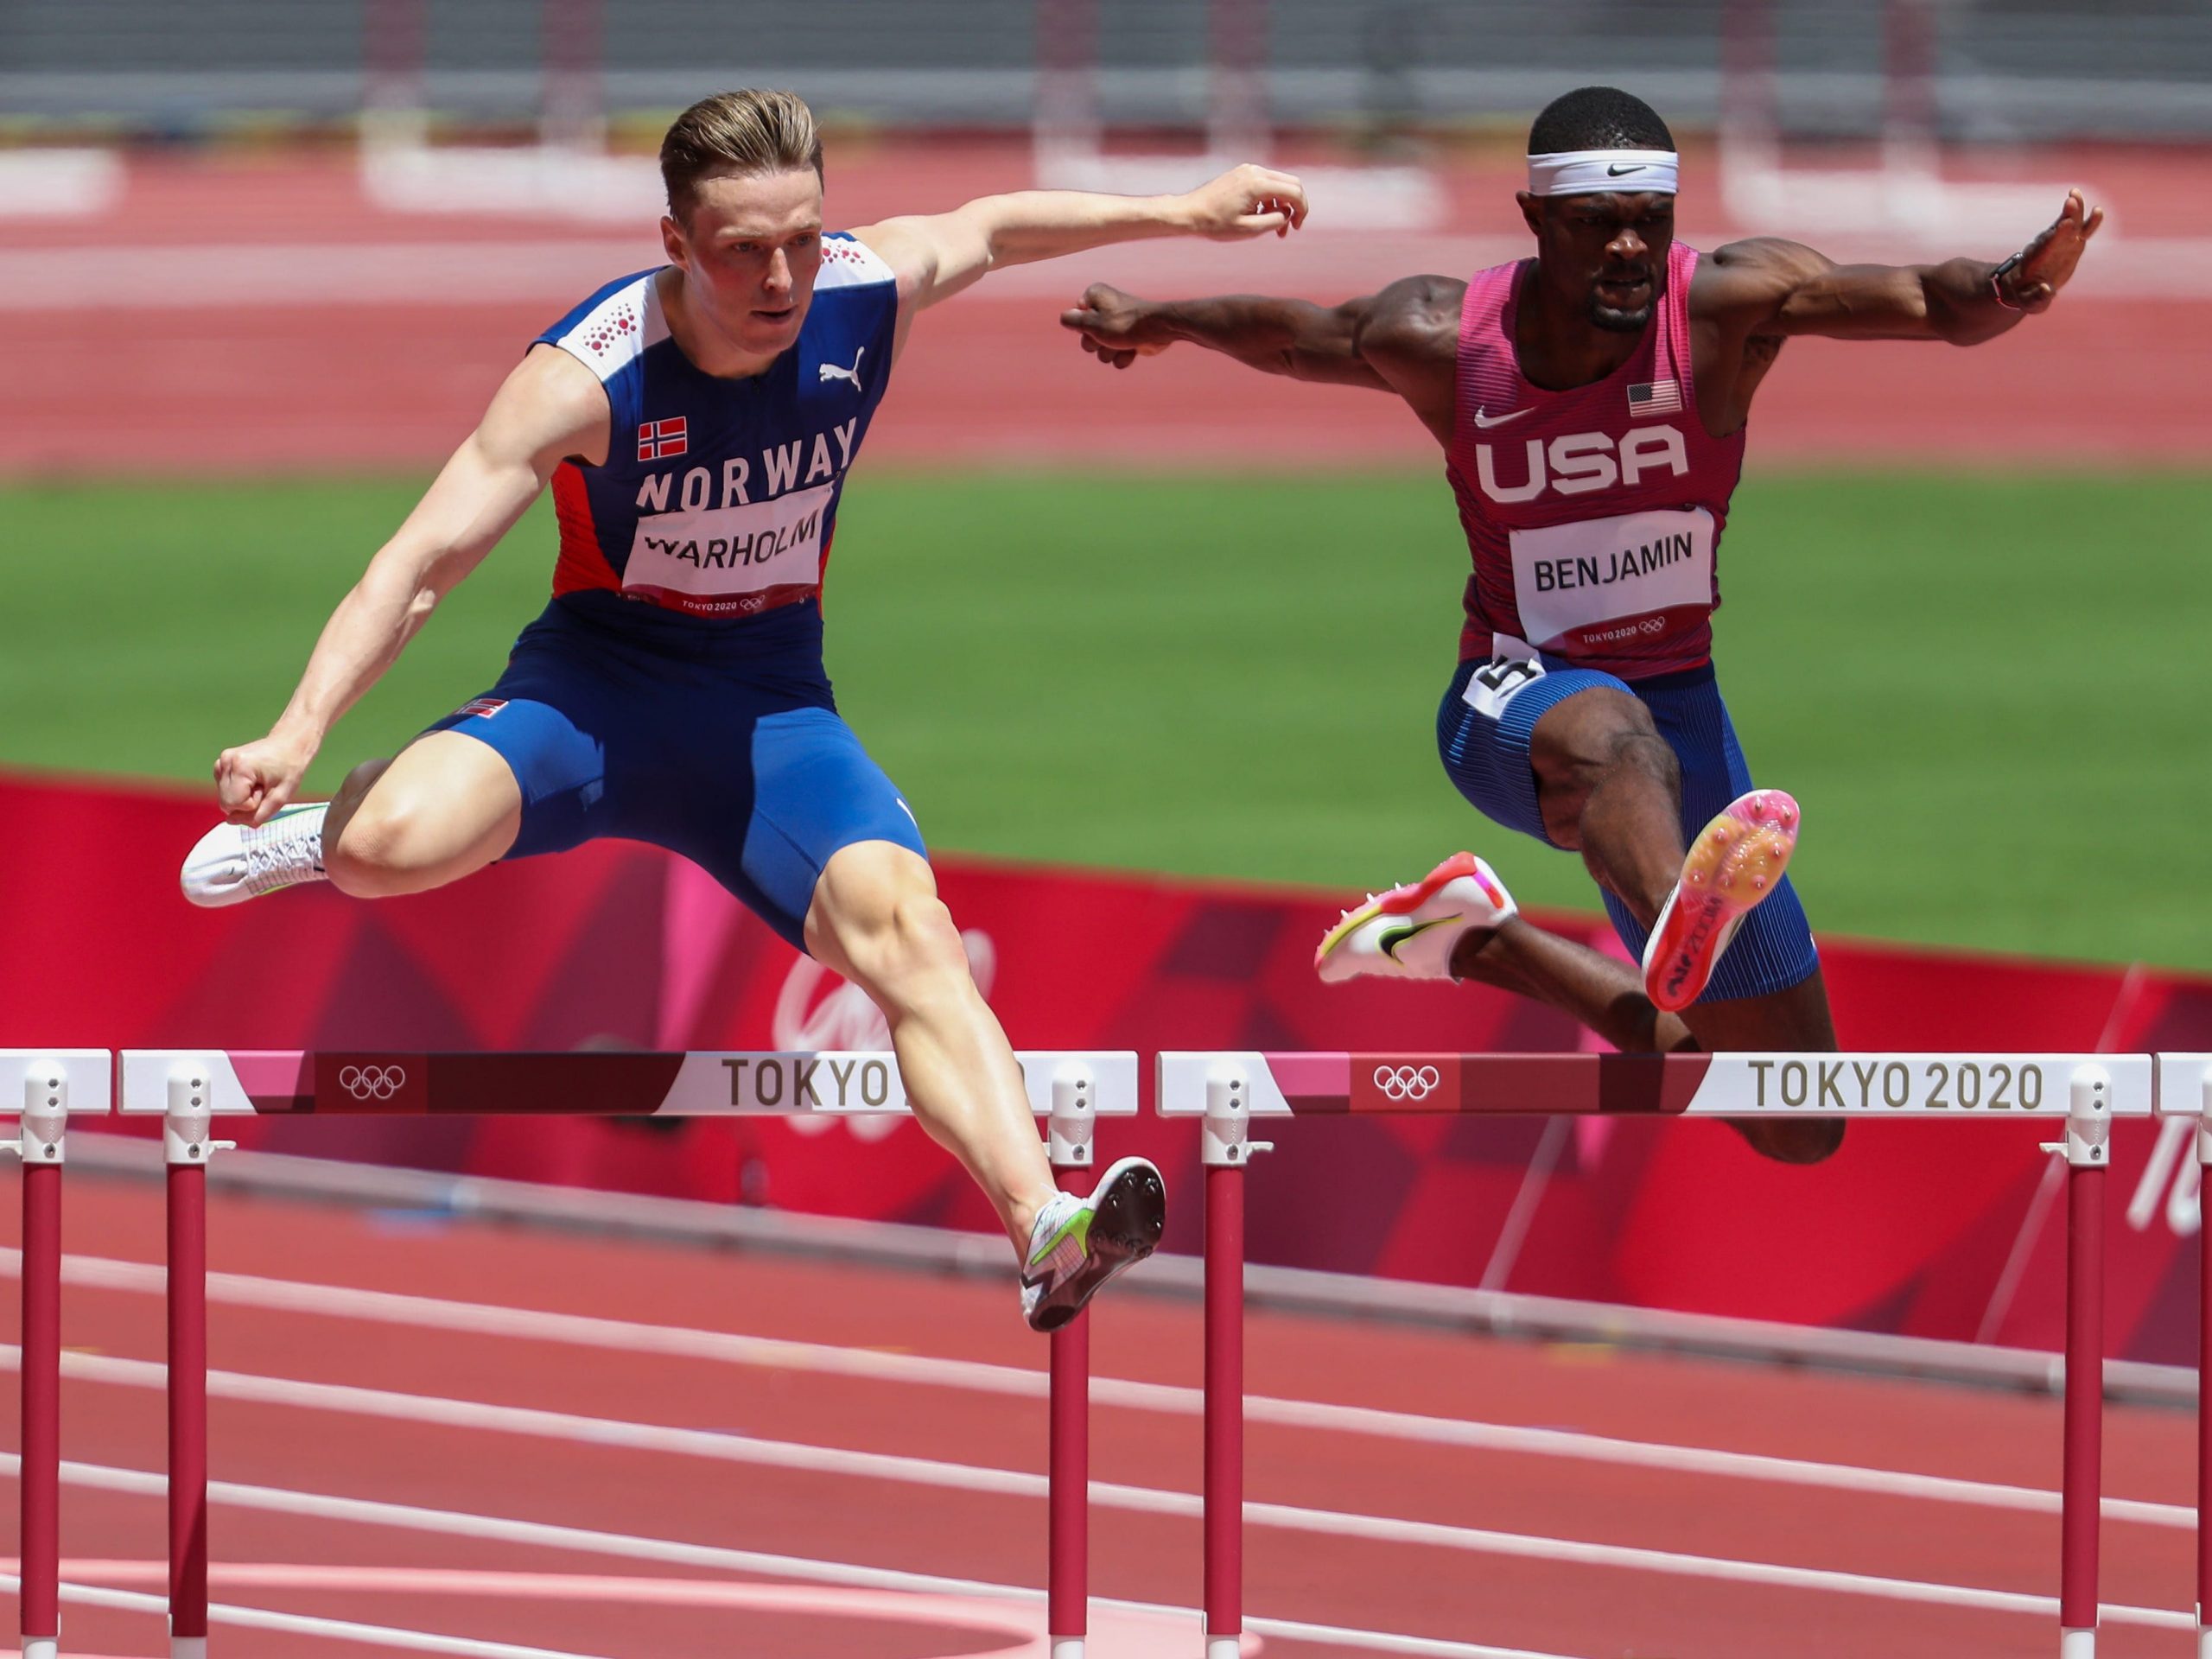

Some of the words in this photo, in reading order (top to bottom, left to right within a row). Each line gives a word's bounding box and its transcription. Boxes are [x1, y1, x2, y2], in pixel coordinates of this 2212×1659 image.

[636, 416, 856, 512] NORWAY
[1476, 424, 1689, 503] USA
[645, 509, 818, 569] WARHOLM
[1535, 531, 1693, 593] BENJAMIN
[683, 600, 713, 612] TOKYO
[715, 601, 736, 611] 2020
[1583, 631, 1613, 644] TOKYO
[1614, 626, 1637, 639] 2020
[721, 1058, 888, 1107] TOKYO
[1747, 1060, 1910, 1107] TOKYO
[1925, 1063, 2044, 1110] 2020
